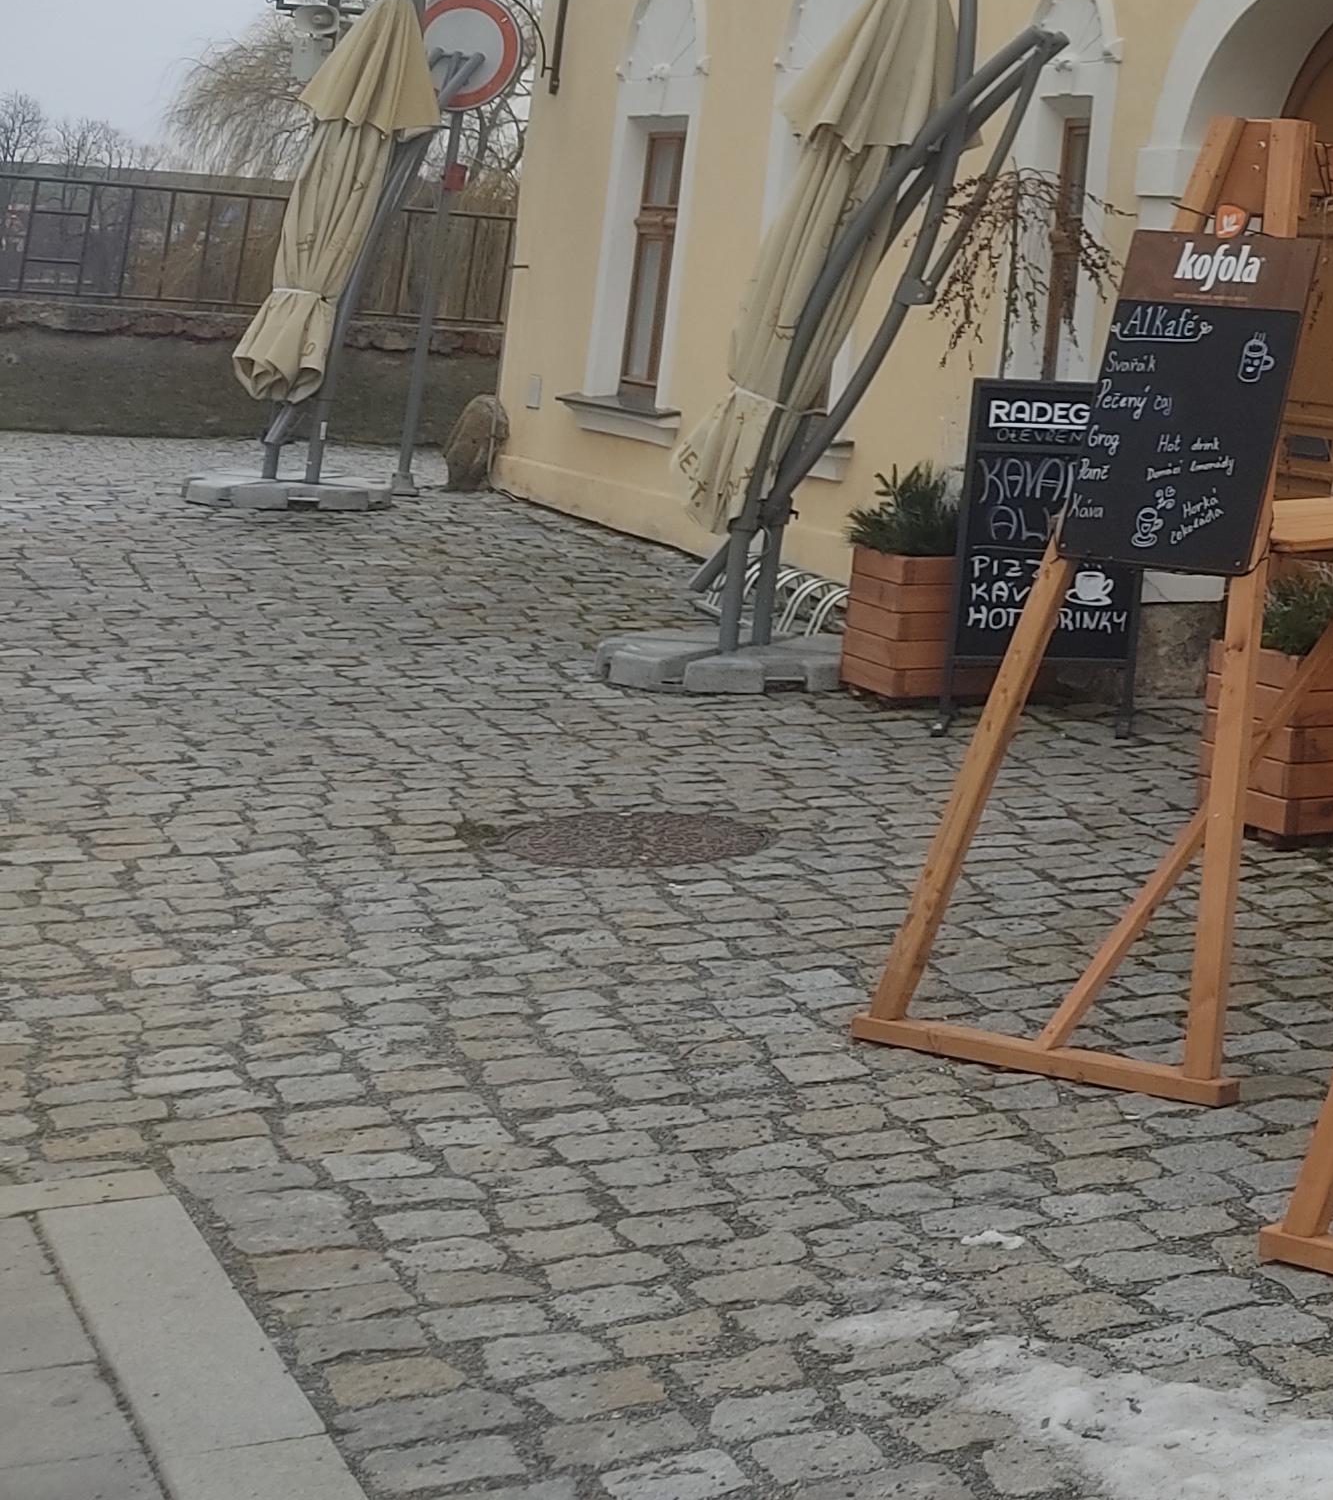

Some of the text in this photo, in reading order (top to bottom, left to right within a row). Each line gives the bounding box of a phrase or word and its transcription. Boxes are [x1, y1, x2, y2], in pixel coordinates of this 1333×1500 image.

[1173, 242, 1262, 291] kofola
[1105, 351, 1156, 372] Svařák
[1095, 378, 1173, 420] Pečený čaj
[989, 400, 1091, 429] RADEG
[1087, 425, 1120, 455] Grog
[1156, 433, 1220, 452] Hot drink
[1067, 492, 1104, 519] Káva
[1182, 487, 1219, 518] Horká
[970, 580, 1032, 603] KÁV
[967, 606, 1128, 635] HOT RINKY
